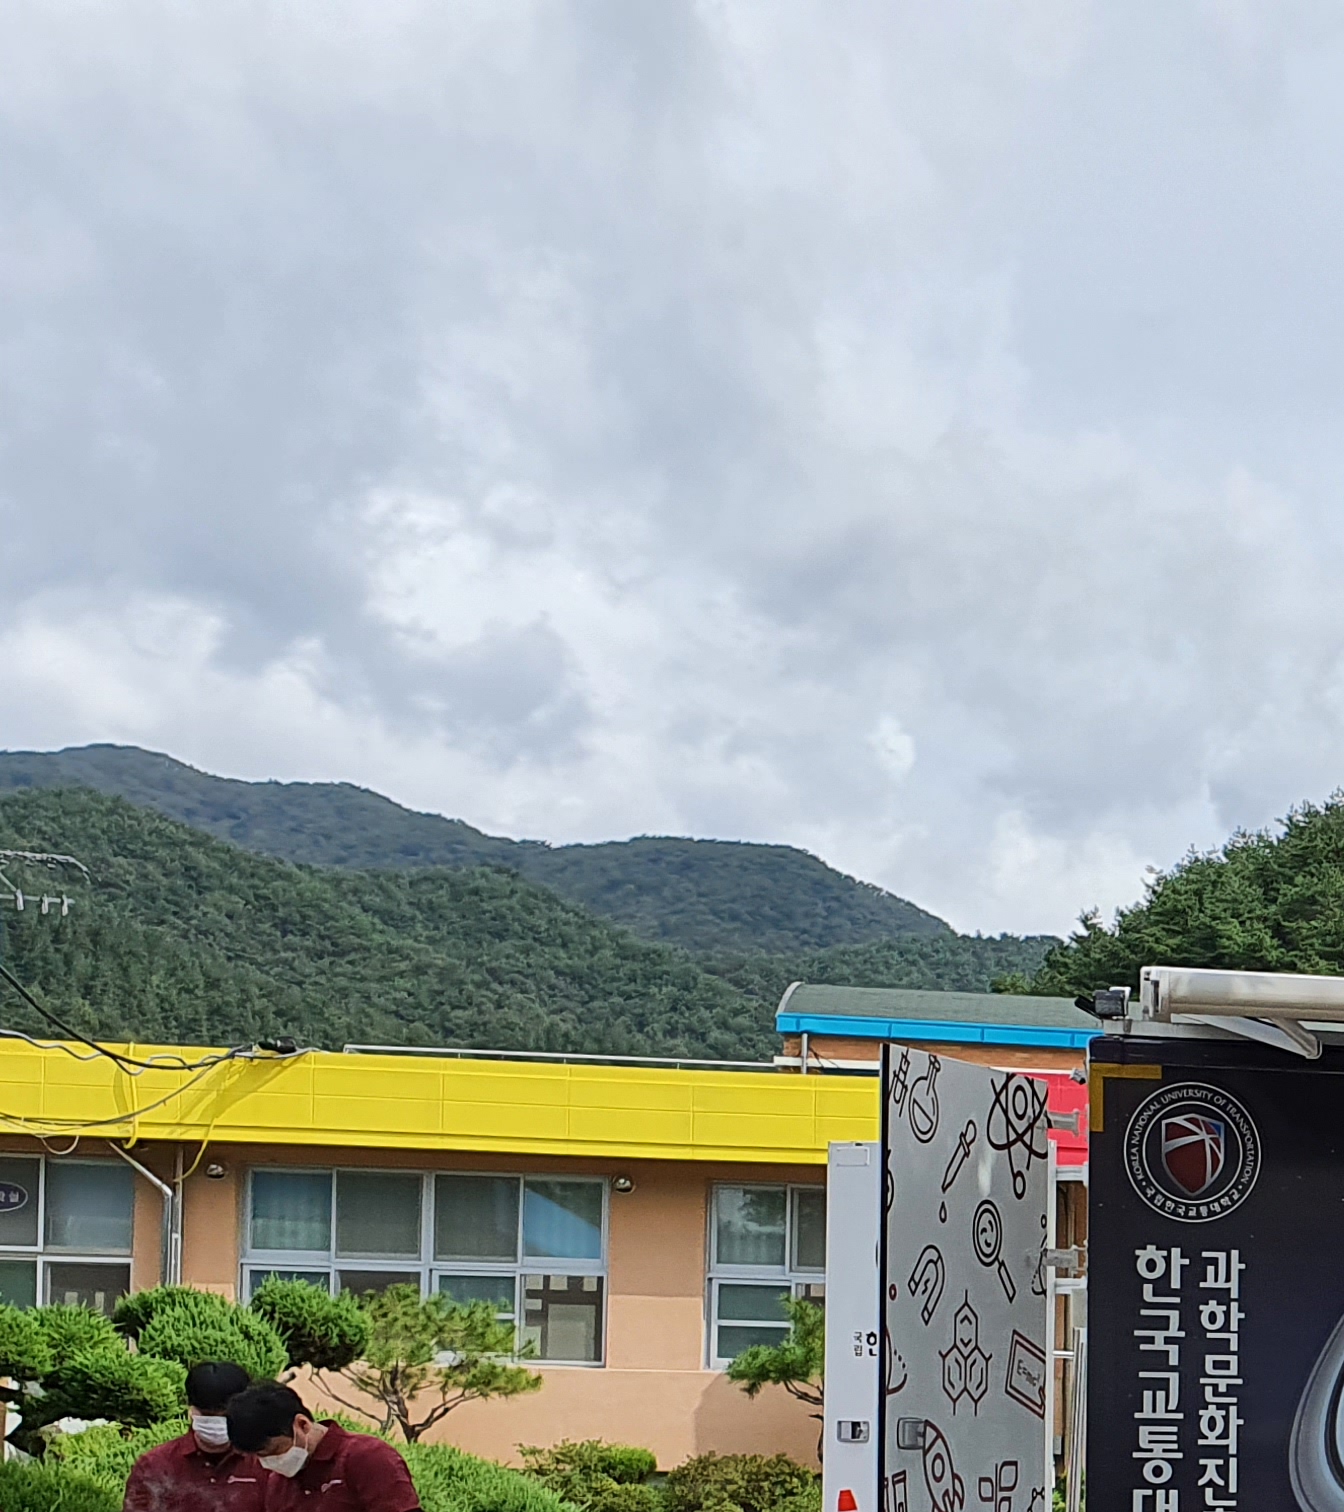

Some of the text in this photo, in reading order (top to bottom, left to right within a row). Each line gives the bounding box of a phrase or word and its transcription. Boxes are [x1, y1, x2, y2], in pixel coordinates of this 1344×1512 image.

[1131, 1089, 1255, 1184] KOREA NATIONAL UNIVERSITY OF TRANSPORTATION
